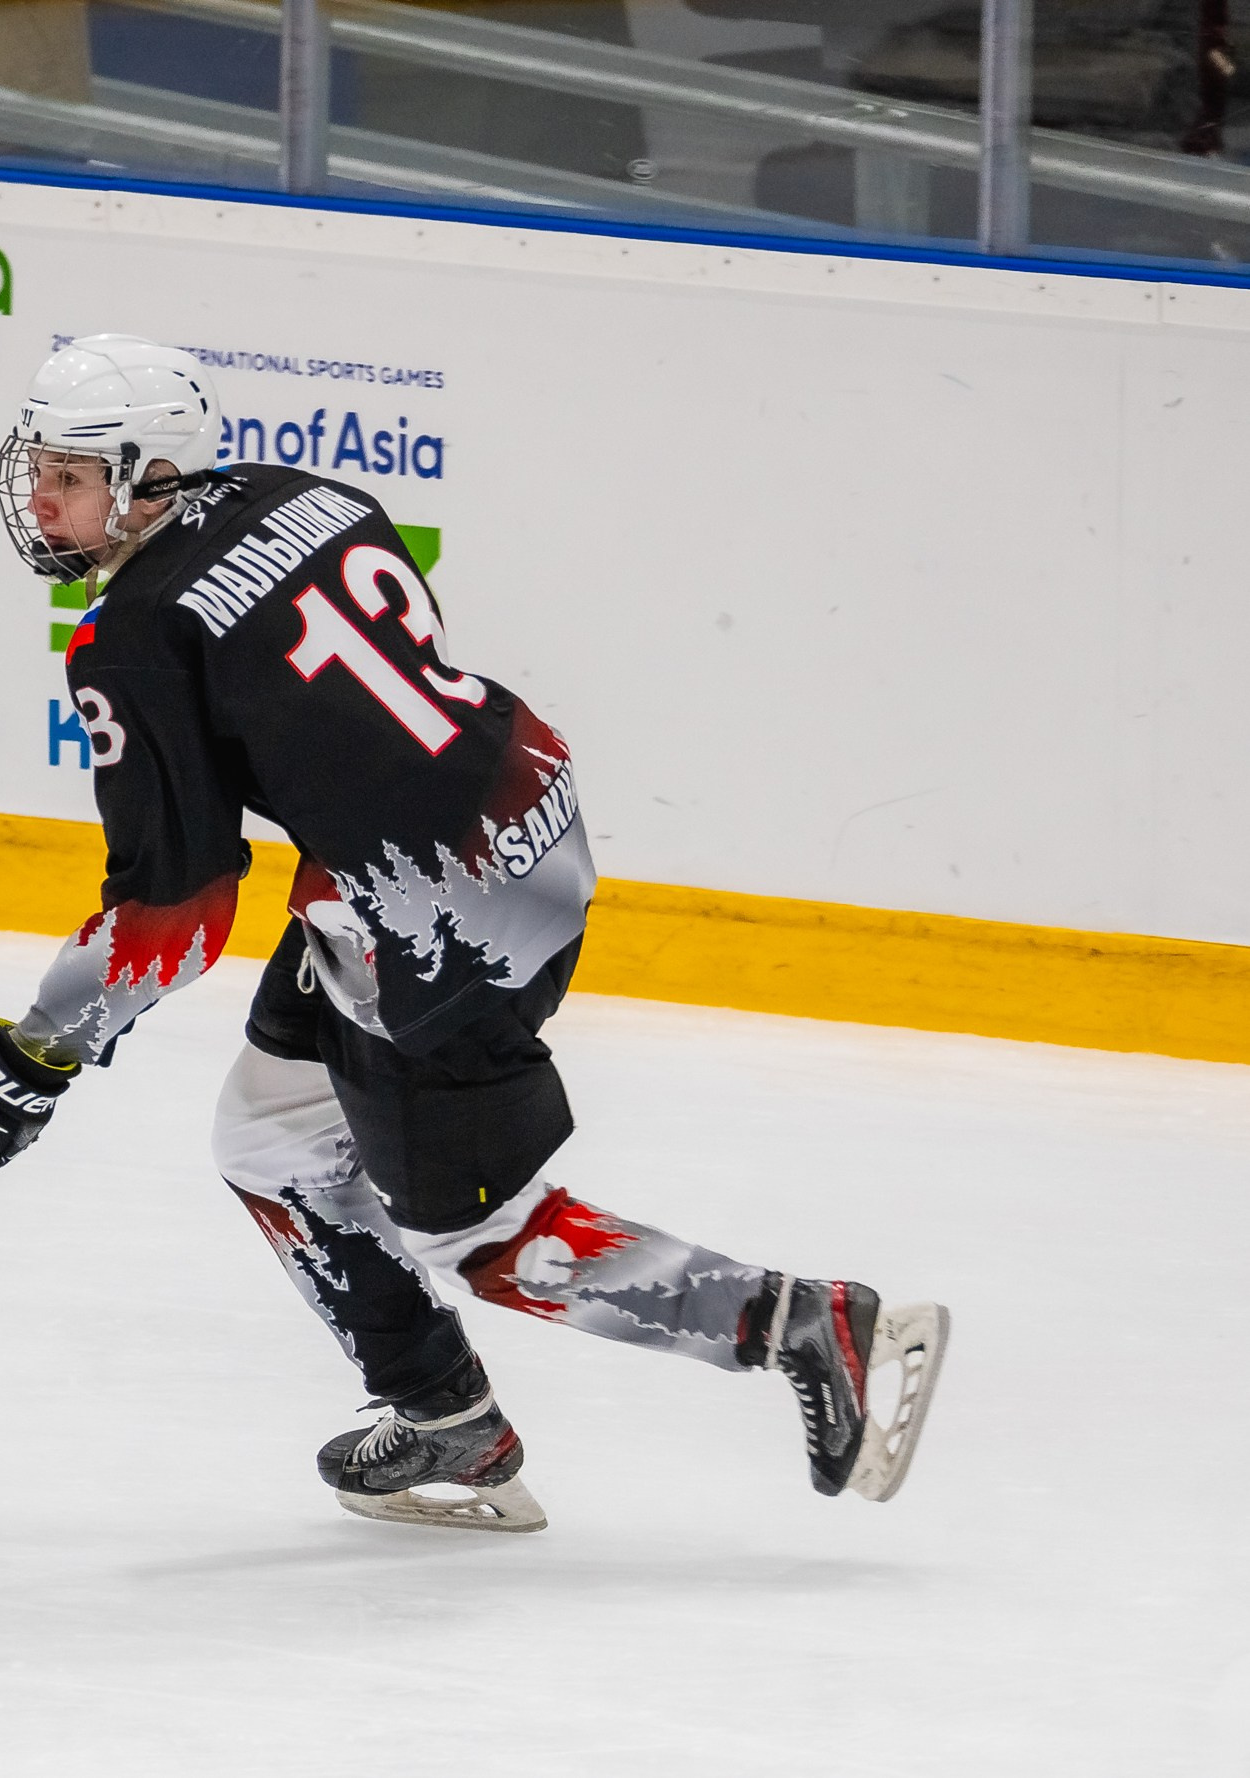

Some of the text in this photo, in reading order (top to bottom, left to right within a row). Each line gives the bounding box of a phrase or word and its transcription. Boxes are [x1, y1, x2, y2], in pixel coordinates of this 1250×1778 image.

[307, 358, 375, 382] SPORTS
[380, 366, 444, 389] GAMES
[275, 408, 326, 466] of
[332, 411, 444, 480] Asia
[176, 486, 373, 639] МАЛЫШКИН
[284, 543, 488, 758] 13
